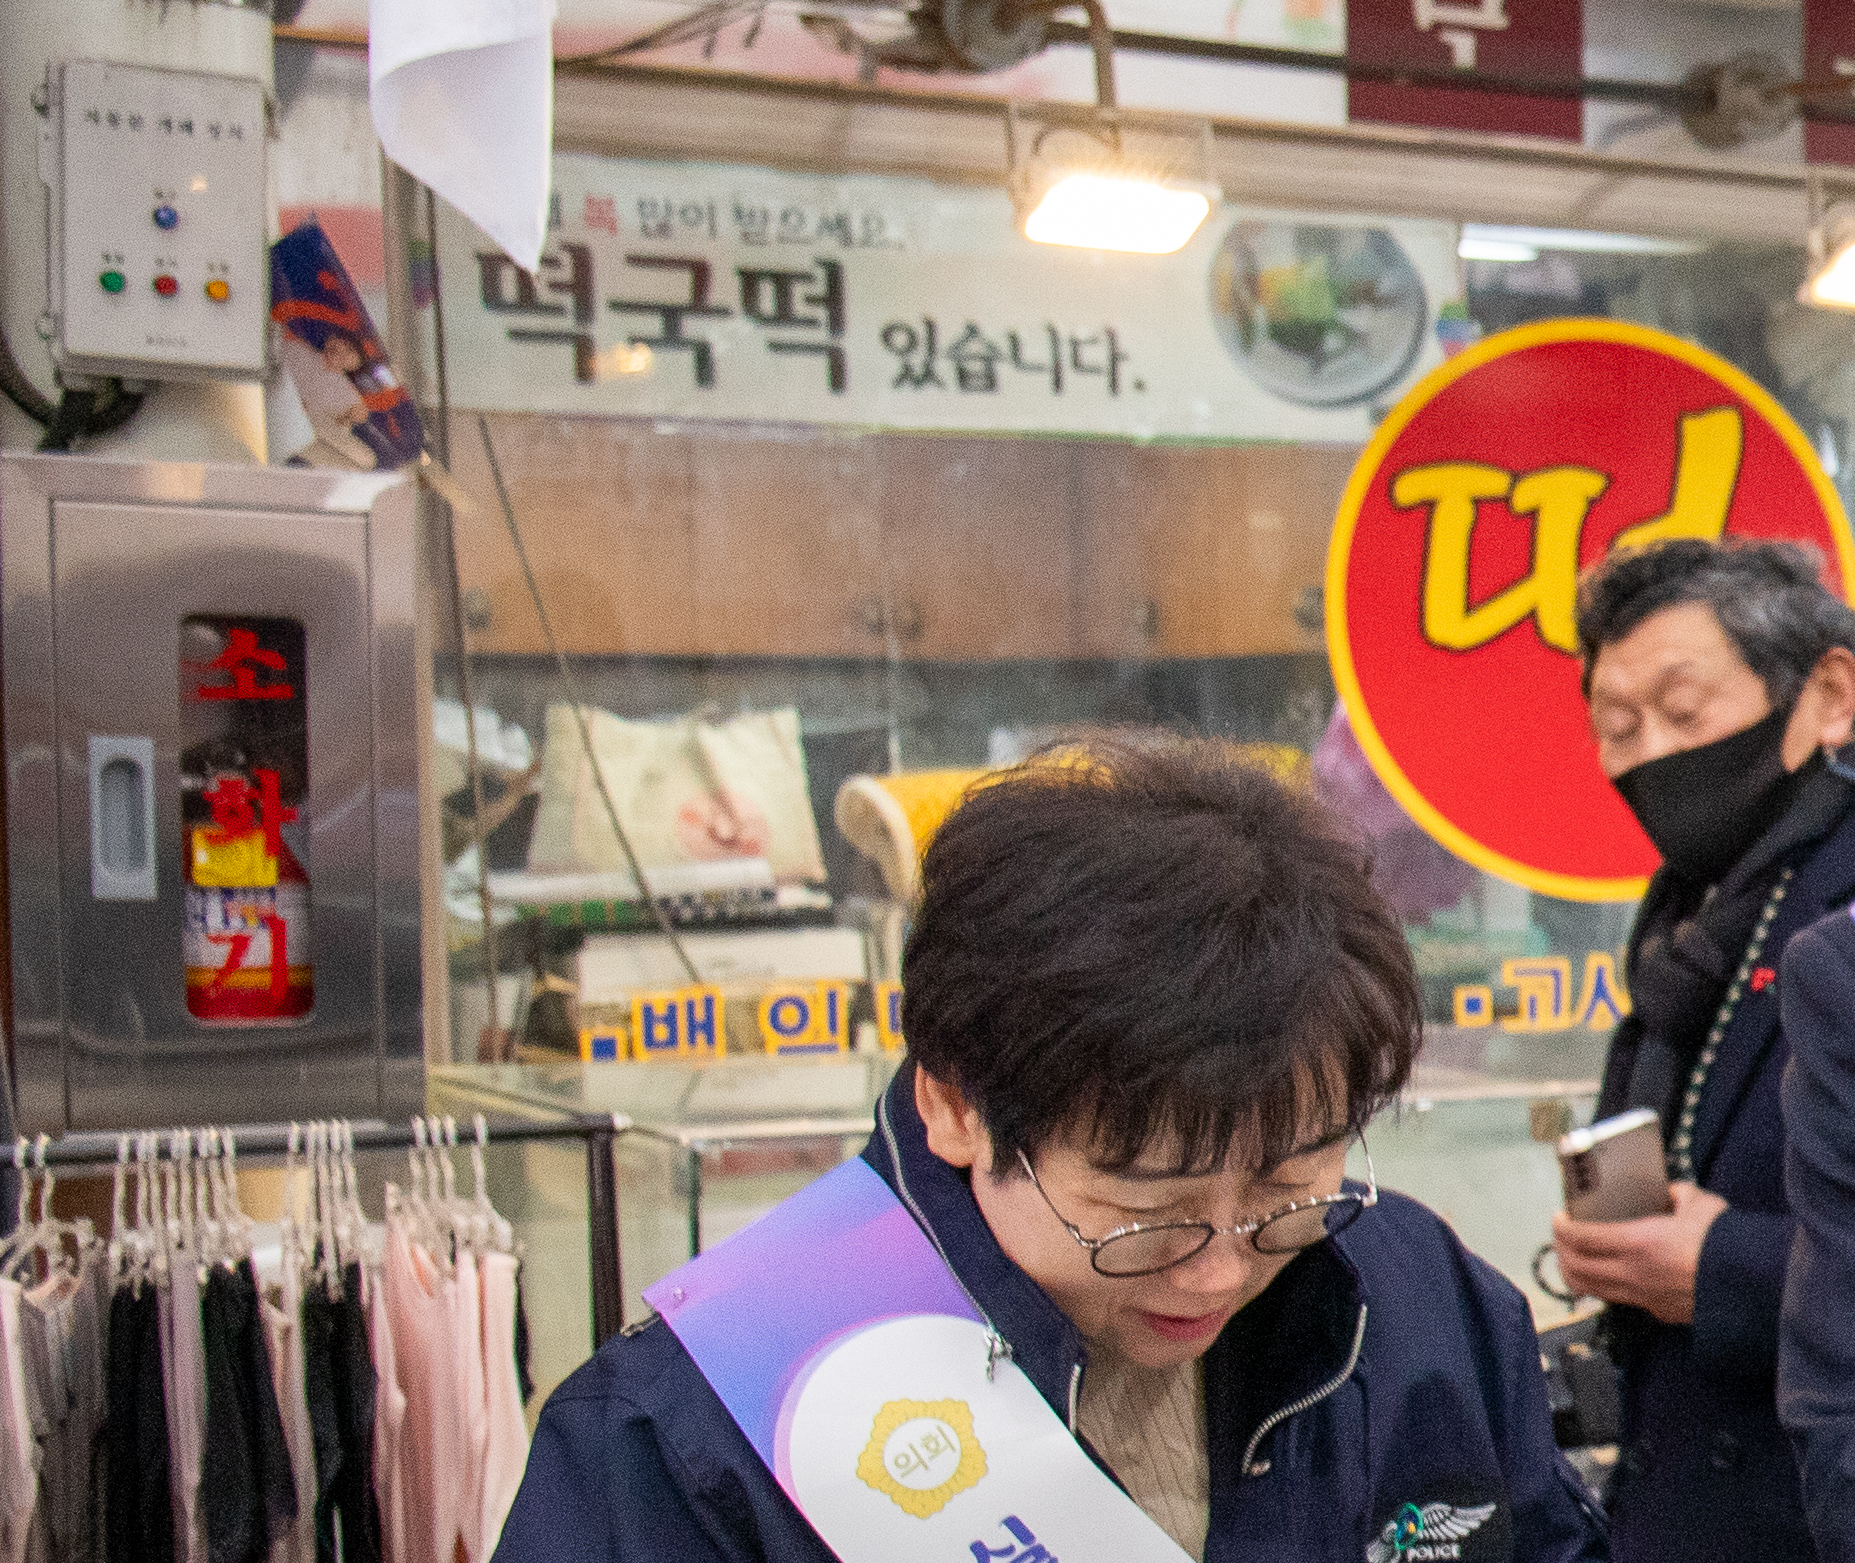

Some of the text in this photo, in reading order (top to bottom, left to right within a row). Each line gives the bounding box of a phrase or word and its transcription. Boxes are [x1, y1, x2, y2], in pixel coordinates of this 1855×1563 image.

[636, 195, 720, 242] 많이
[475, 243, 1148, 397] 떡국떡 있습니다.
[198, 626, 298, 1002] 소화기
[891, 1422, 958, 1480] 의회
[1407, 1543, 1461, 1563] POLICE
